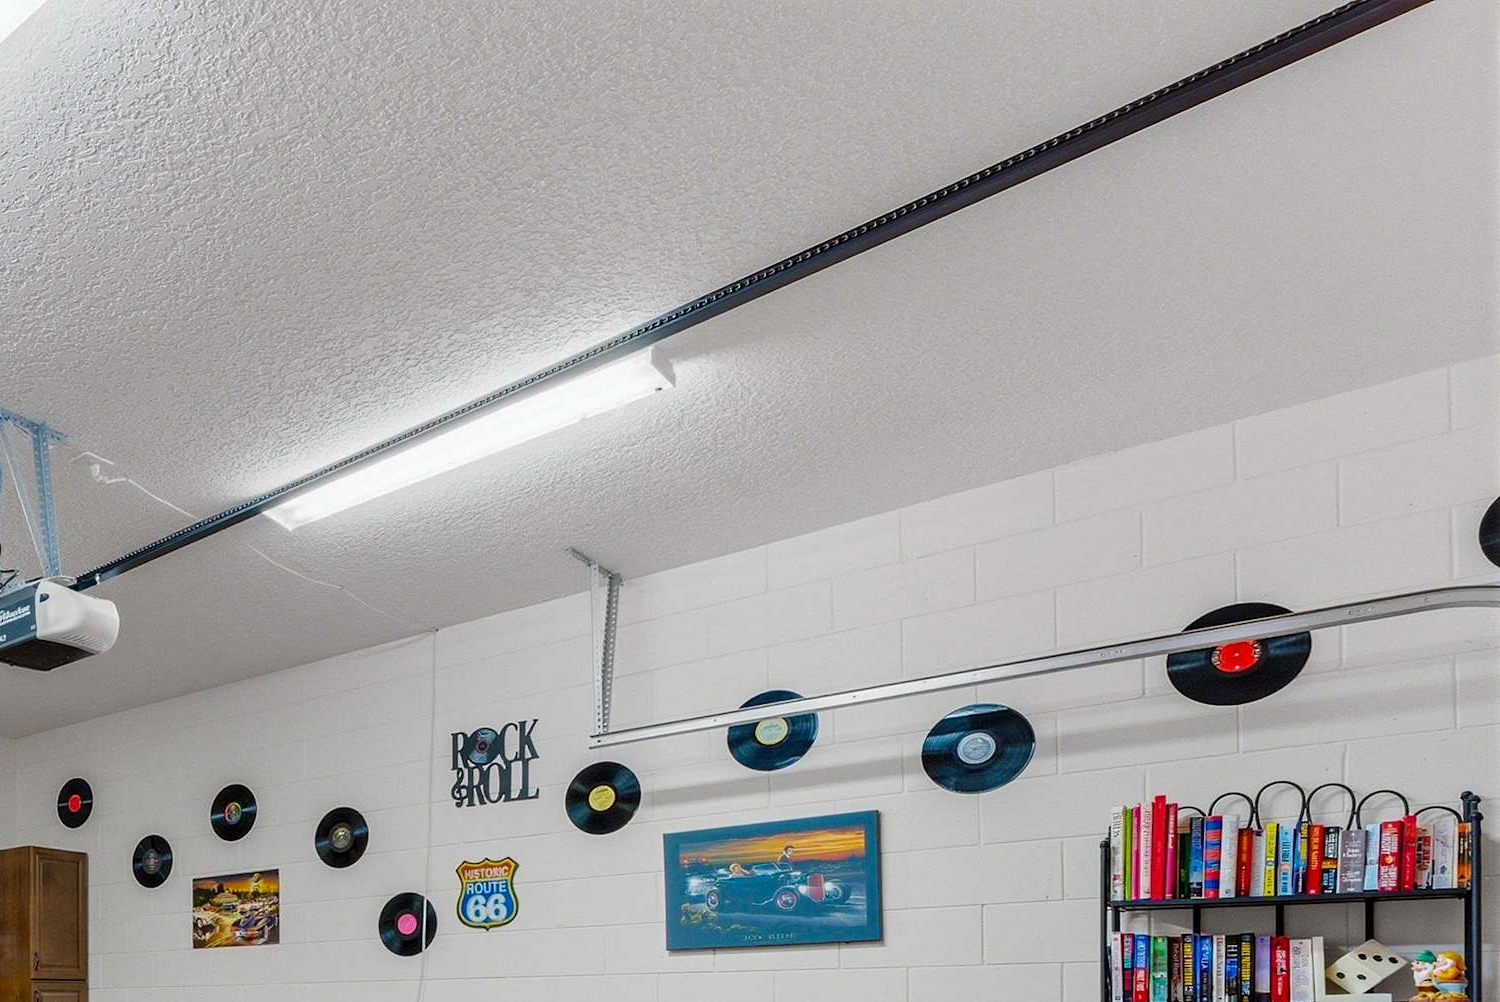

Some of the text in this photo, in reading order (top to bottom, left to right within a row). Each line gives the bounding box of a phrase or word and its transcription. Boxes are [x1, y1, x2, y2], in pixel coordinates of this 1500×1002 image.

[451, 719, 540, 771] ROCK
[465, 865, 509, 880] HISTORIC
[466, 880, 507, 895] ROUTE
[466, 893, 508, 923] 66
